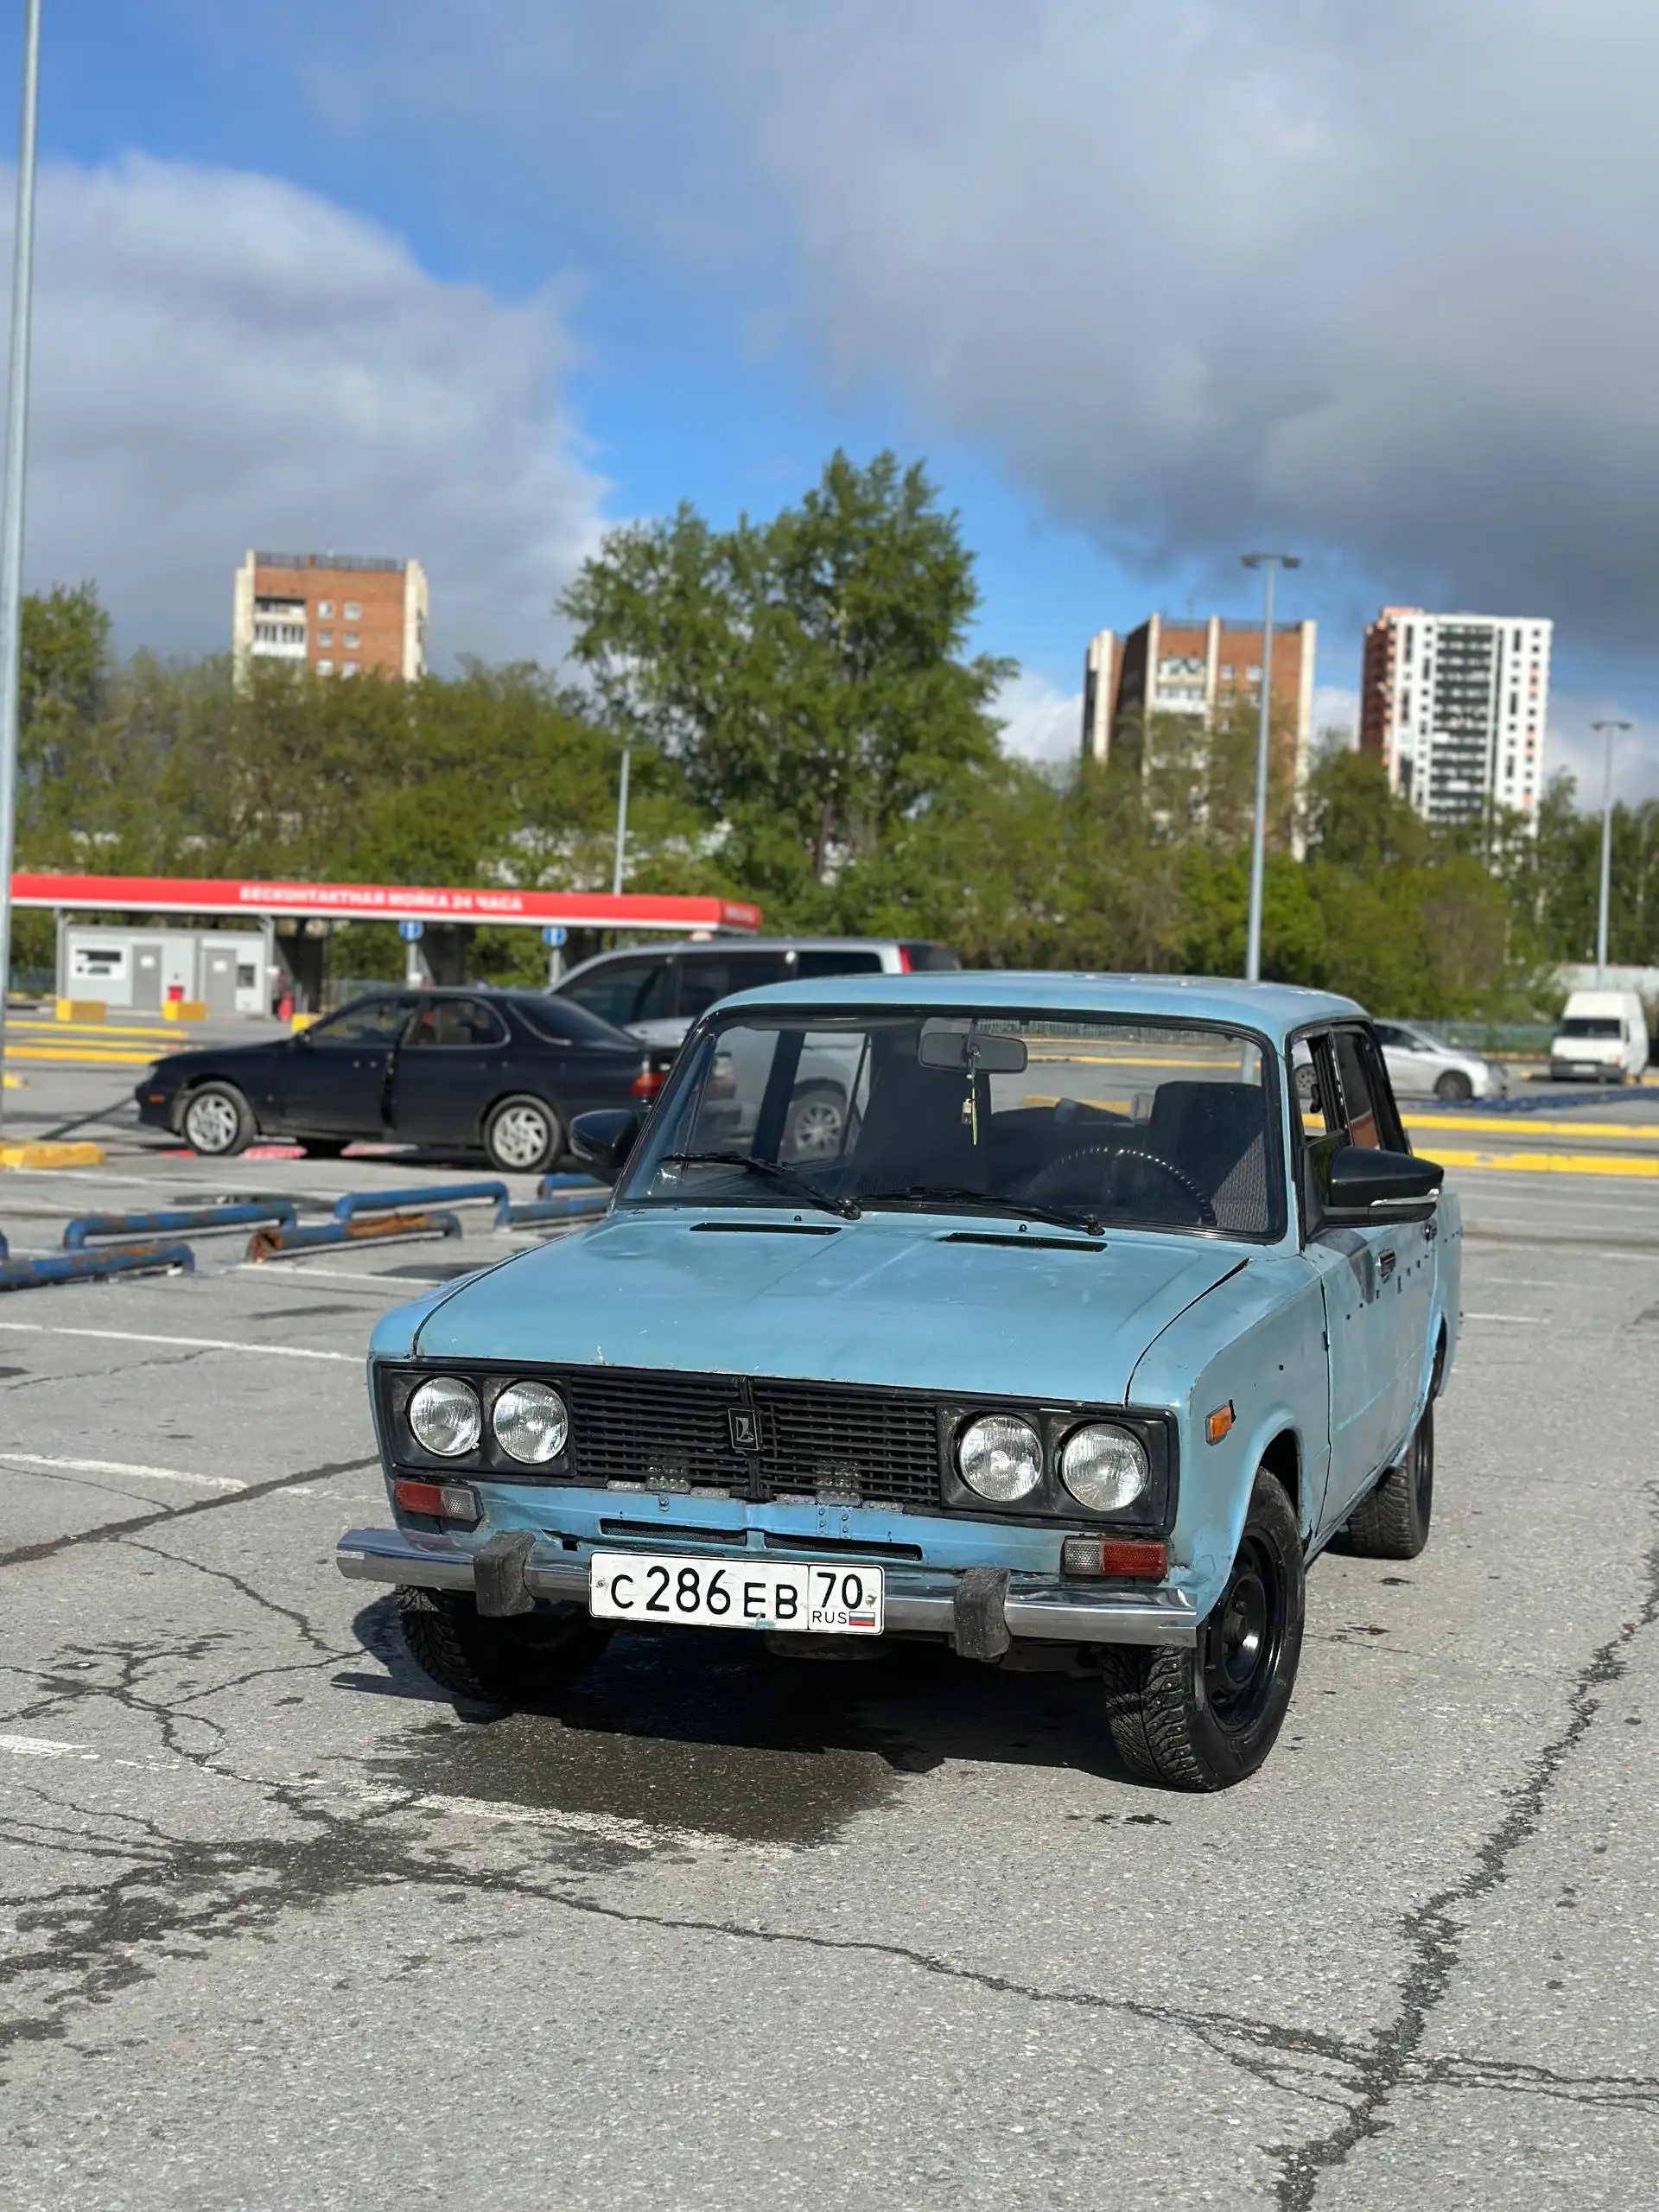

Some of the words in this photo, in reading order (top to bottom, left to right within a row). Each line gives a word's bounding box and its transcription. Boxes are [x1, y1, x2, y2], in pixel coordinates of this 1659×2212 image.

[239, 886, 385, 906] БЕСКОНТАКТНАЯ
[388, 890, 448, 908] МОЙКА
[451, 894, 473, 910] 24
[476, 895, 524, 912] ЧАСА
[817, 1572, 863, 1610] 70
[812, 1611, 848, 1624] RUS
